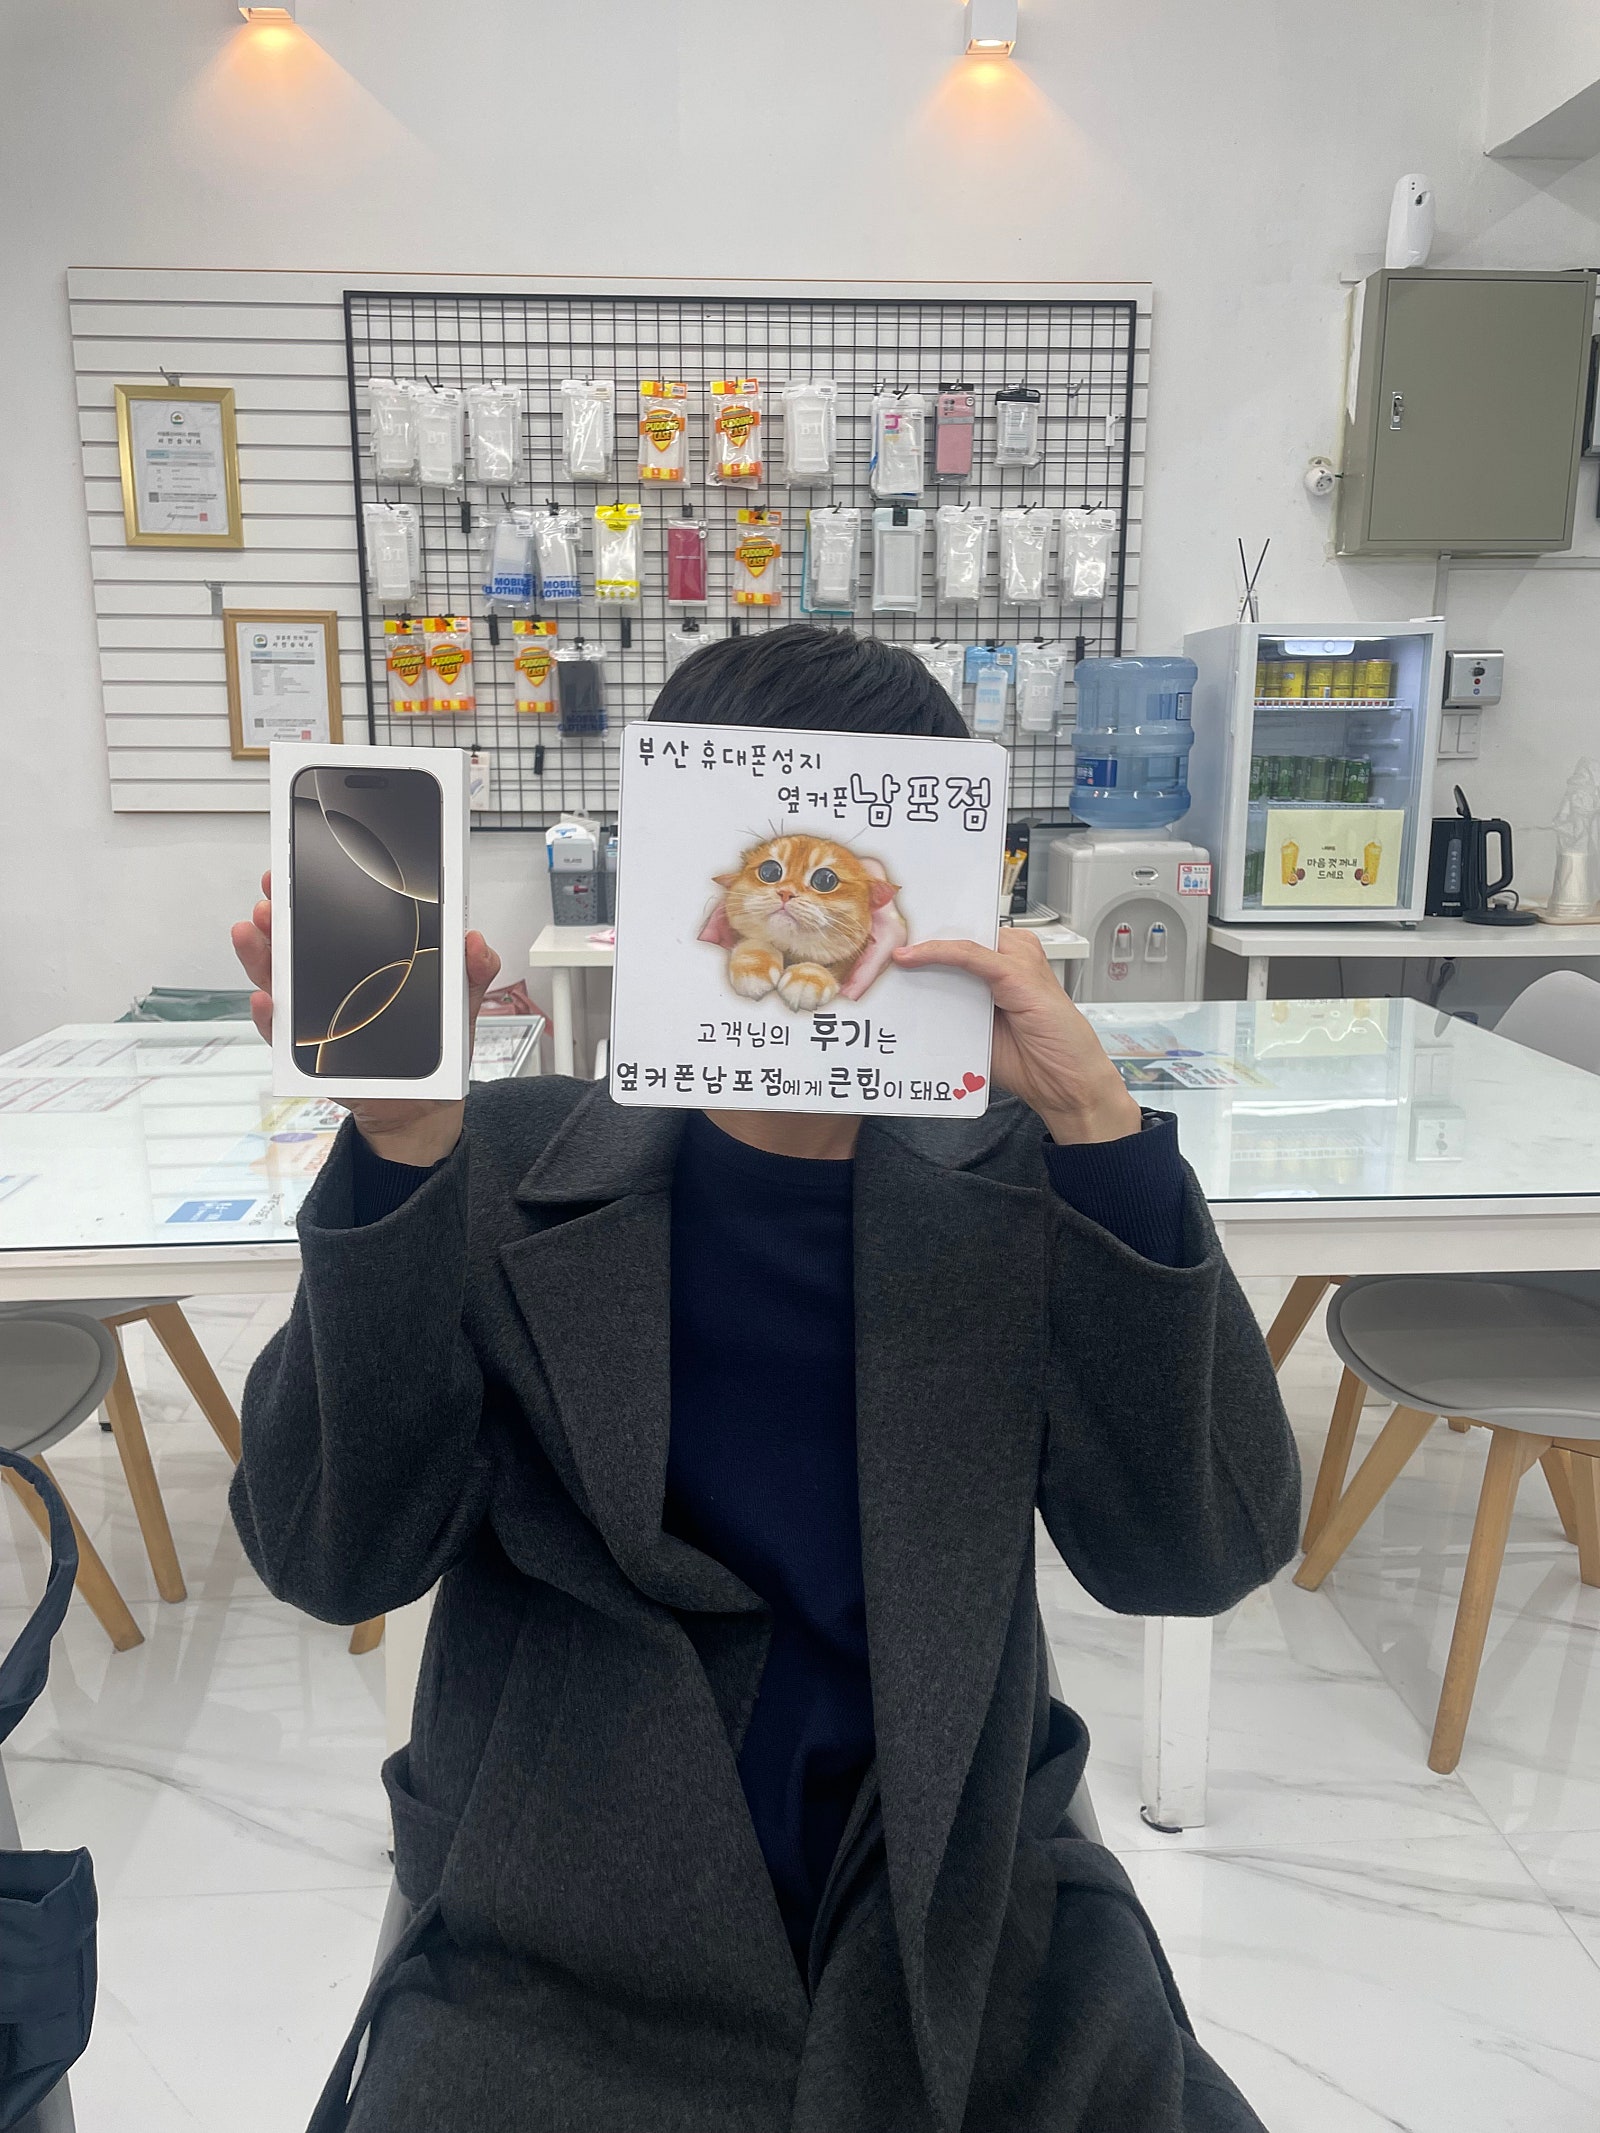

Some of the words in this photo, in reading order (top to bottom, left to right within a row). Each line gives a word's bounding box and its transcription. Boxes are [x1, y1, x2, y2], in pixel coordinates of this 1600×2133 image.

[543, 581, 582, 589] MOBILE
[639, 738, 689, 768] 부산
[701, 740, 821, 777] 휴대폰성지
[1317, 870, 1344, 879] 드세요
[697, 1022, 790, 1047] 고객님의
[809, 1013, 897, 1054] 후기는
[910, 1081, 952, 1101] 돼요
